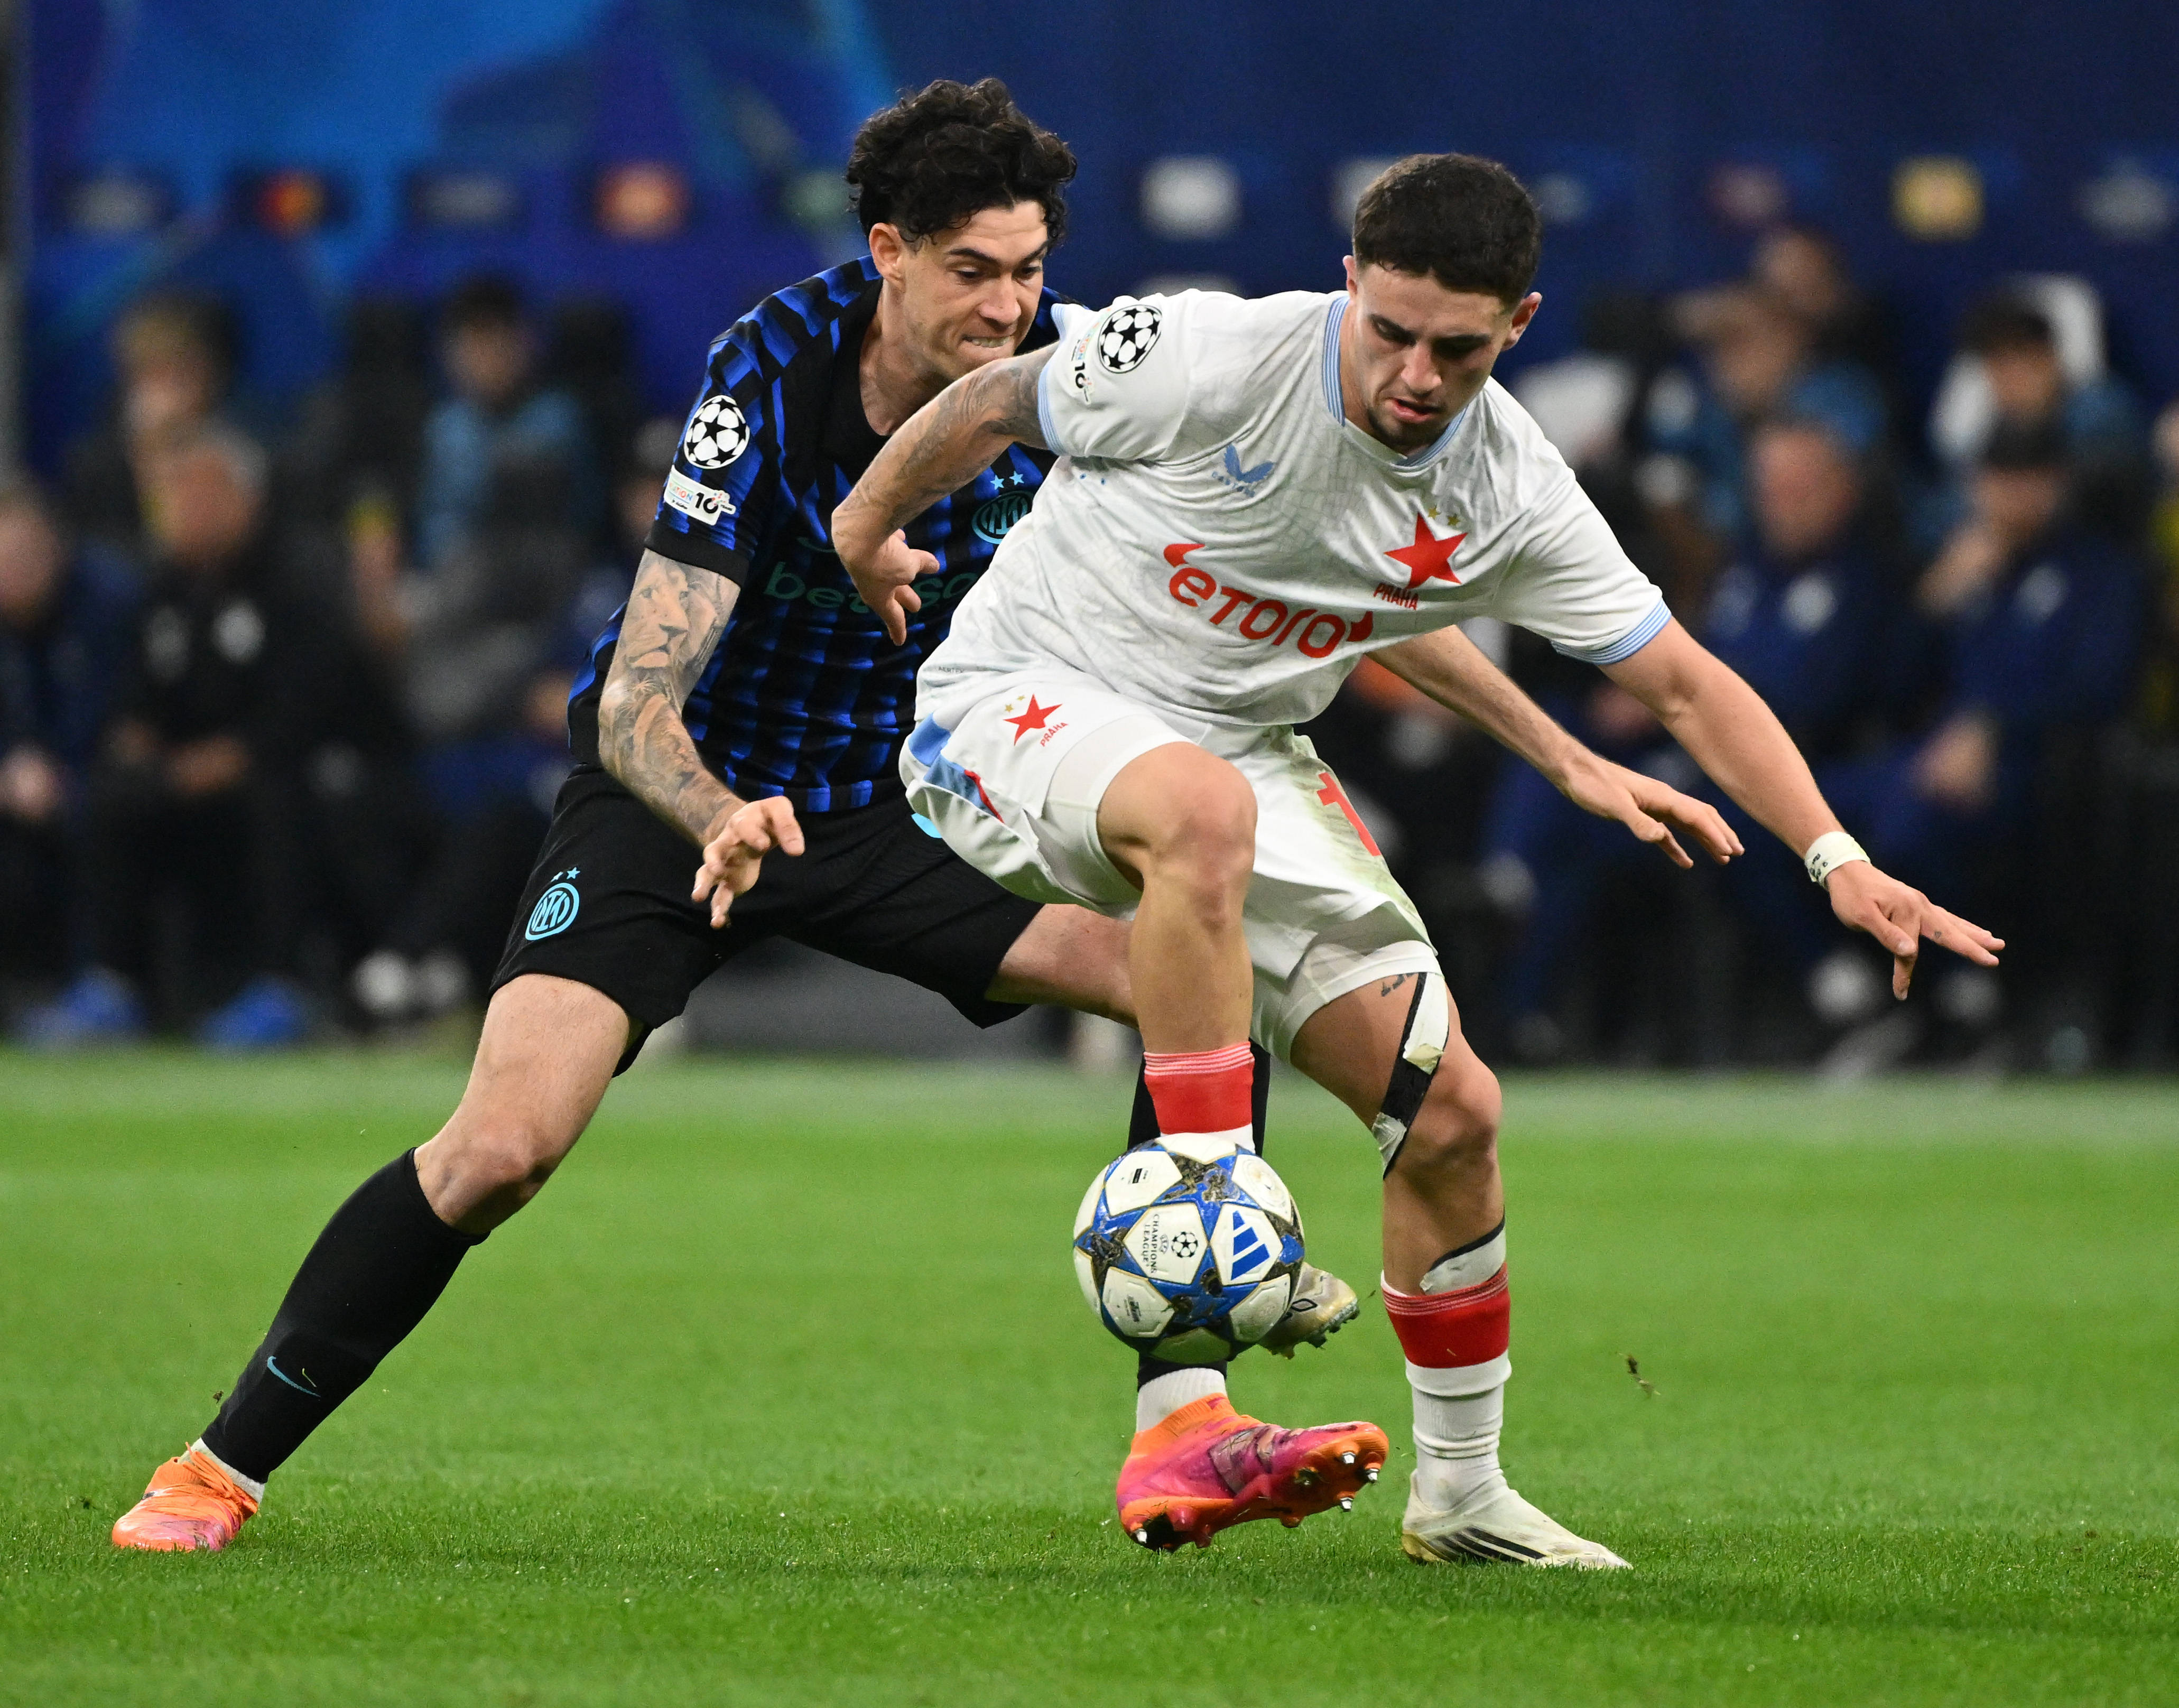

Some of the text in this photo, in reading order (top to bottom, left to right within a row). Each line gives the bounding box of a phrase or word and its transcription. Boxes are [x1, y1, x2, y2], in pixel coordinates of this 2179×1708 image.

[1373, 582, 1419, 610] PRAHA
[1040, 722, 1069, 747] PRAHA
[1142, 1224, 1151, 1263] LEAGUE
[1151, 1213, 1160, 1274] CHAMPIONS
